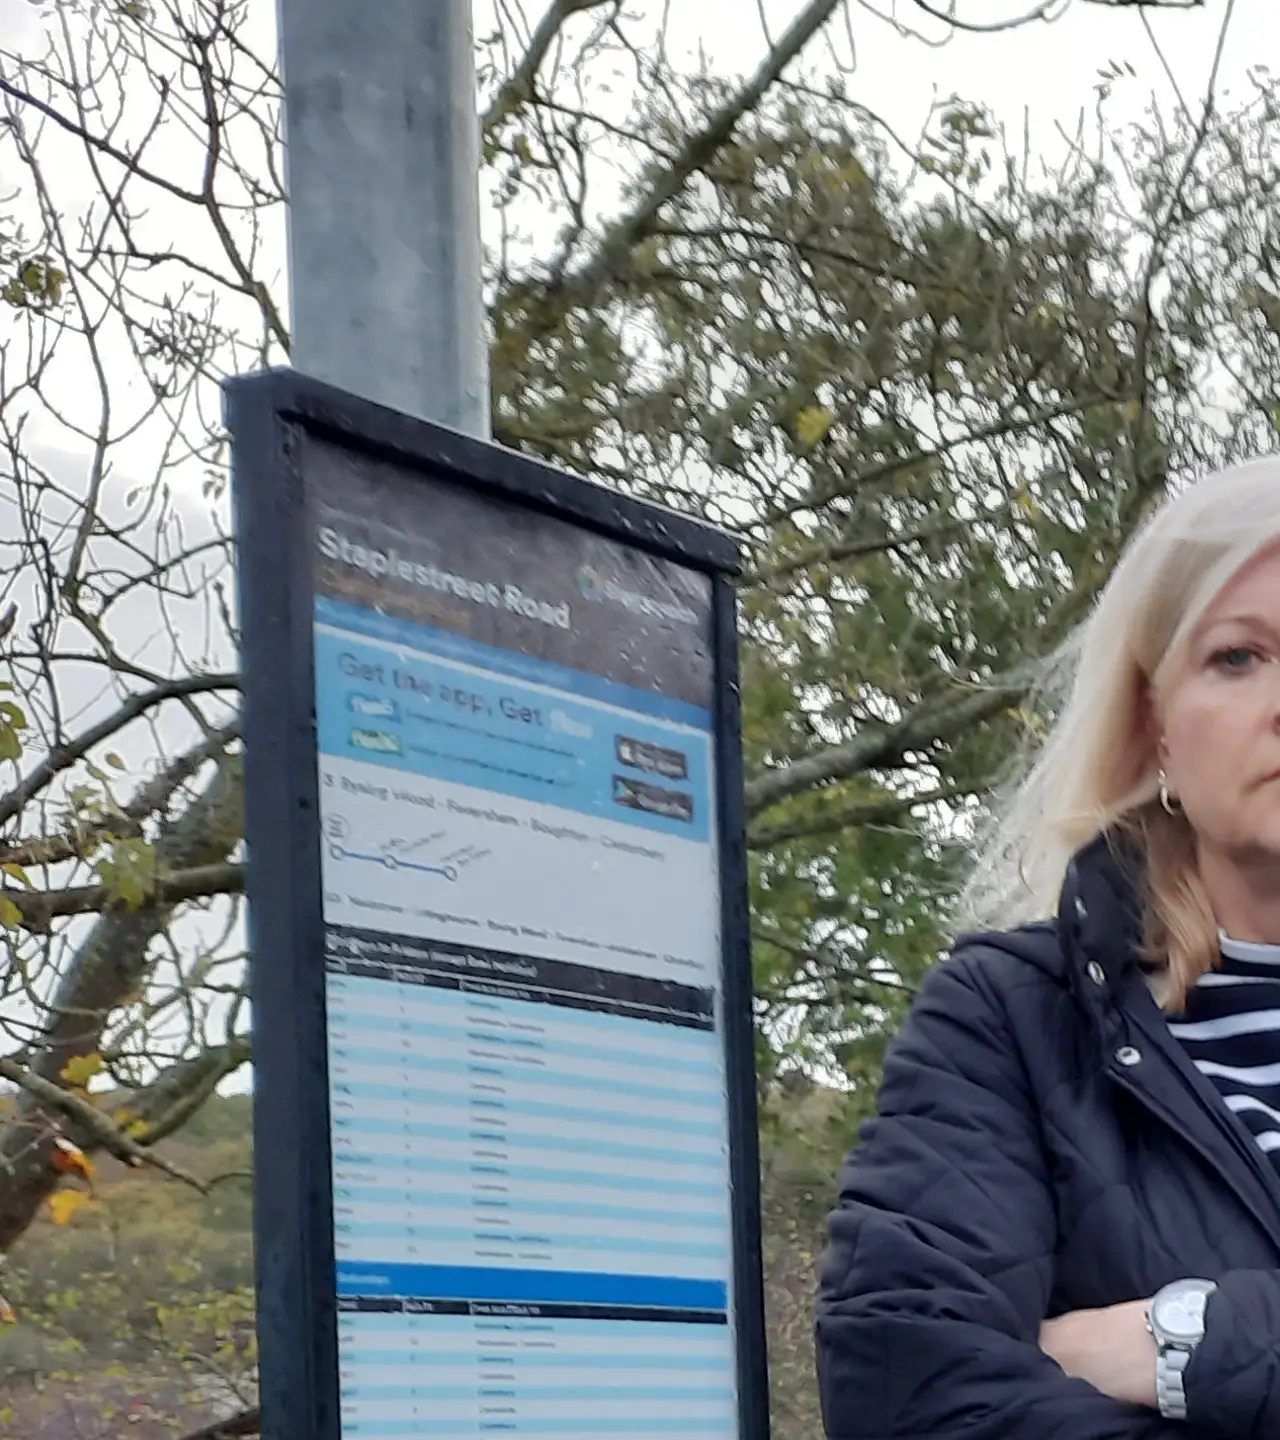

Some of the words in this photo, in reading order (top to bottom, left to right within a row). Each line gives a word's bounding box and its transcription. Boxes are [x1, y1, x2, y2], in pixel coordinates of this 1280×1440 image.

[318, 526, 500, 608] Staplestreet
[504, 583, 571, 629] Road
[338, 652, 385, 685] Get
[499, 696, 543, 726] Get
